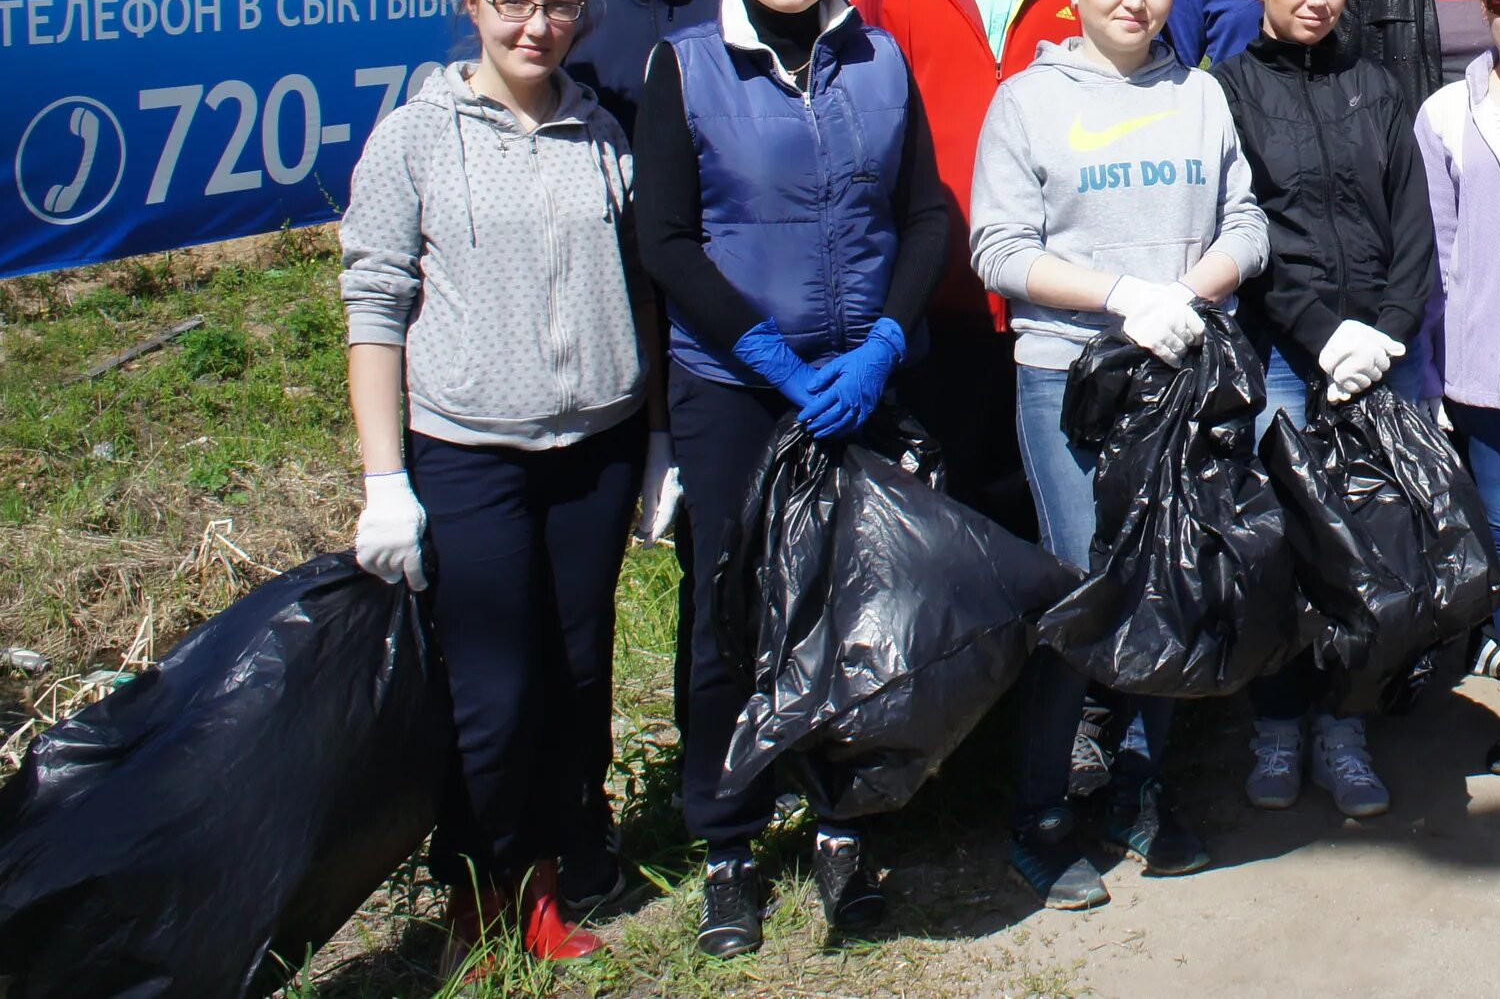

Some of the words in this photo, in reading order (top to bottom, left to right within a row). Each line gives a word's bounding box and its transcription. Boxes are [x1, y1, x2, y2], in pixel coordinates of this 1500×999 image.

[1077, 161, 1133, 194] JUST
[1141, 160, 1177, 186] DO
[1186, 158, 1206, 186] IT.
